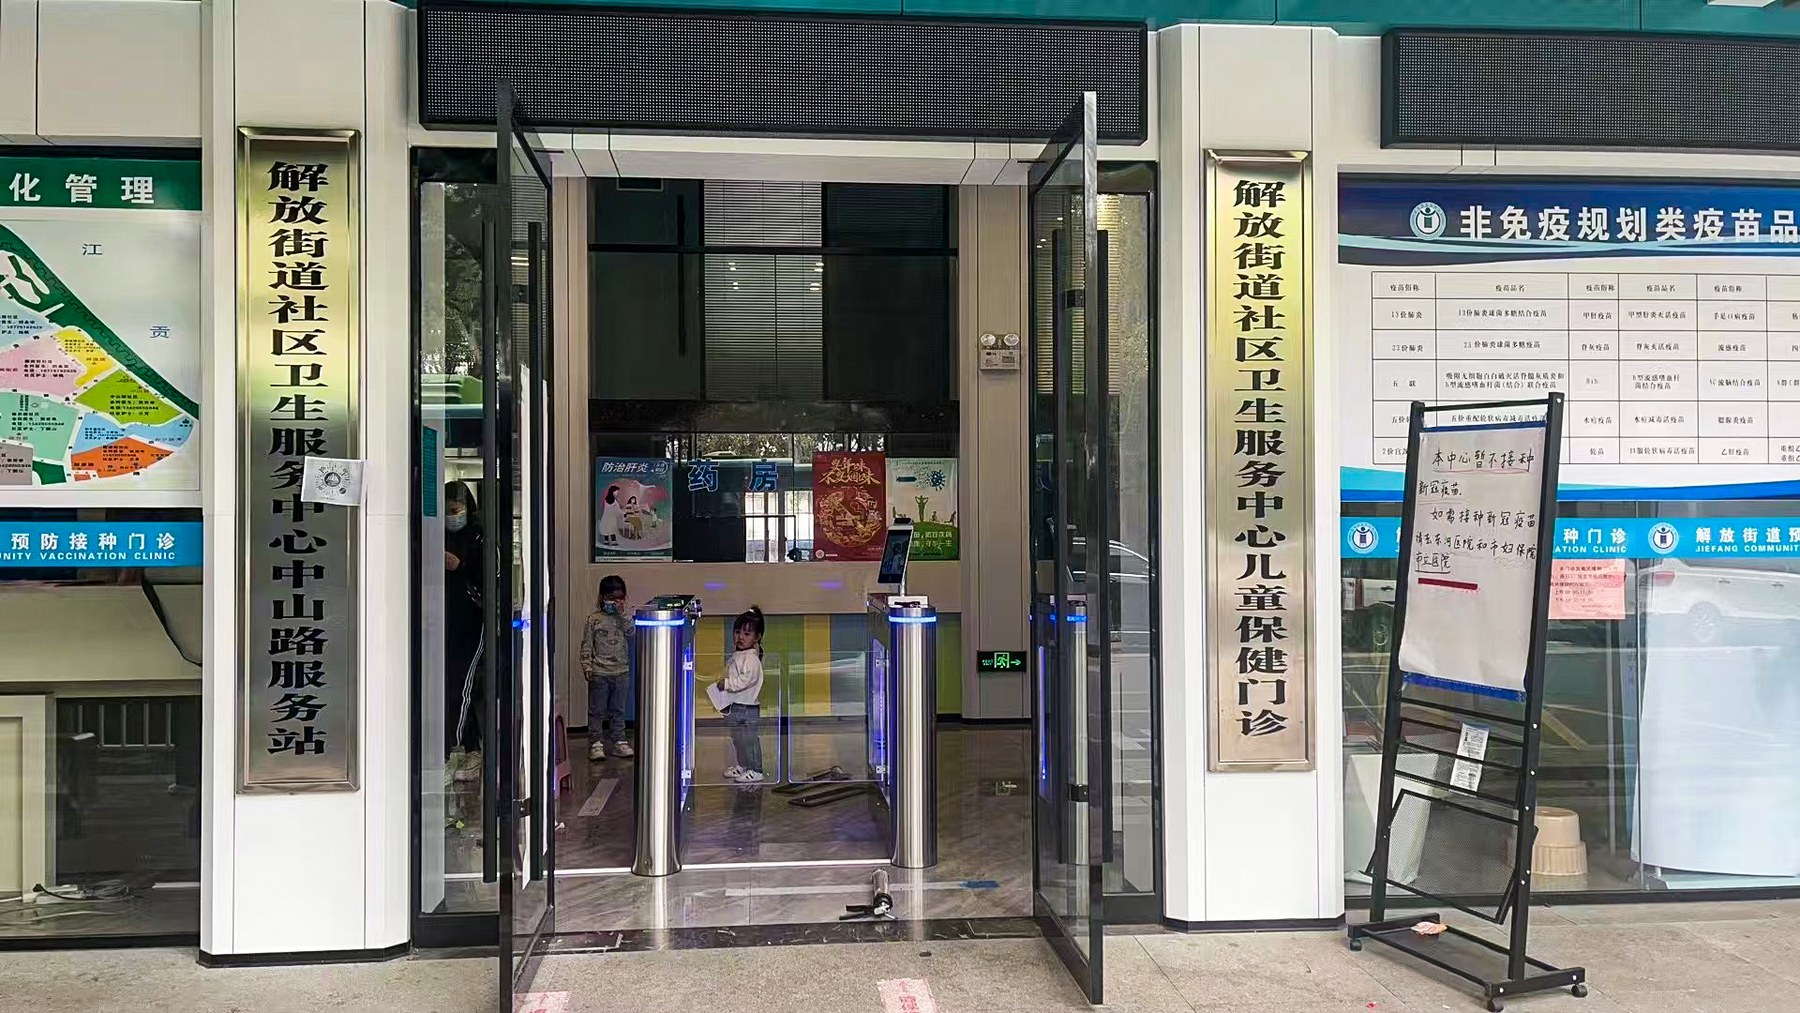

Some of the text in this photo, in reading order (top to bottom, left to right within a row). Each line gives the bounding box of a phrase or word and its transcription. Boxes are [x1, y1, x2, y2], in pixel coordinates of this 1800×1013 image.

[9, 173, 155, 204] 化管理
[1460, 205, 1799, 244] 非免疫规划类疫苗品
[82, 243, 103, 256] 江
[150, 325, 171, 339] 贡
[266, 161, 329, 756] 解放街道社区卫生服务中心中山路服务站
[1232, 179, 1288, 736] 解放街道社区卫生服务中心儿童保健门诊
[1432, 447, 1535, 473] 本中心暂不接种
[601, 462, 648, 473] 防治肝炎
[687, 458, 779, 493] 药房
[11, 533, 175, 550] 预防接种门诊
[1563, 527, 1627, 544] 种门诊
[1695, 527, 1800, 543] 解放街道预
[0, 552, 176, 560] NITY VACCINATION CLINIC
[1593, 545, 1627, 553] CLINIC
